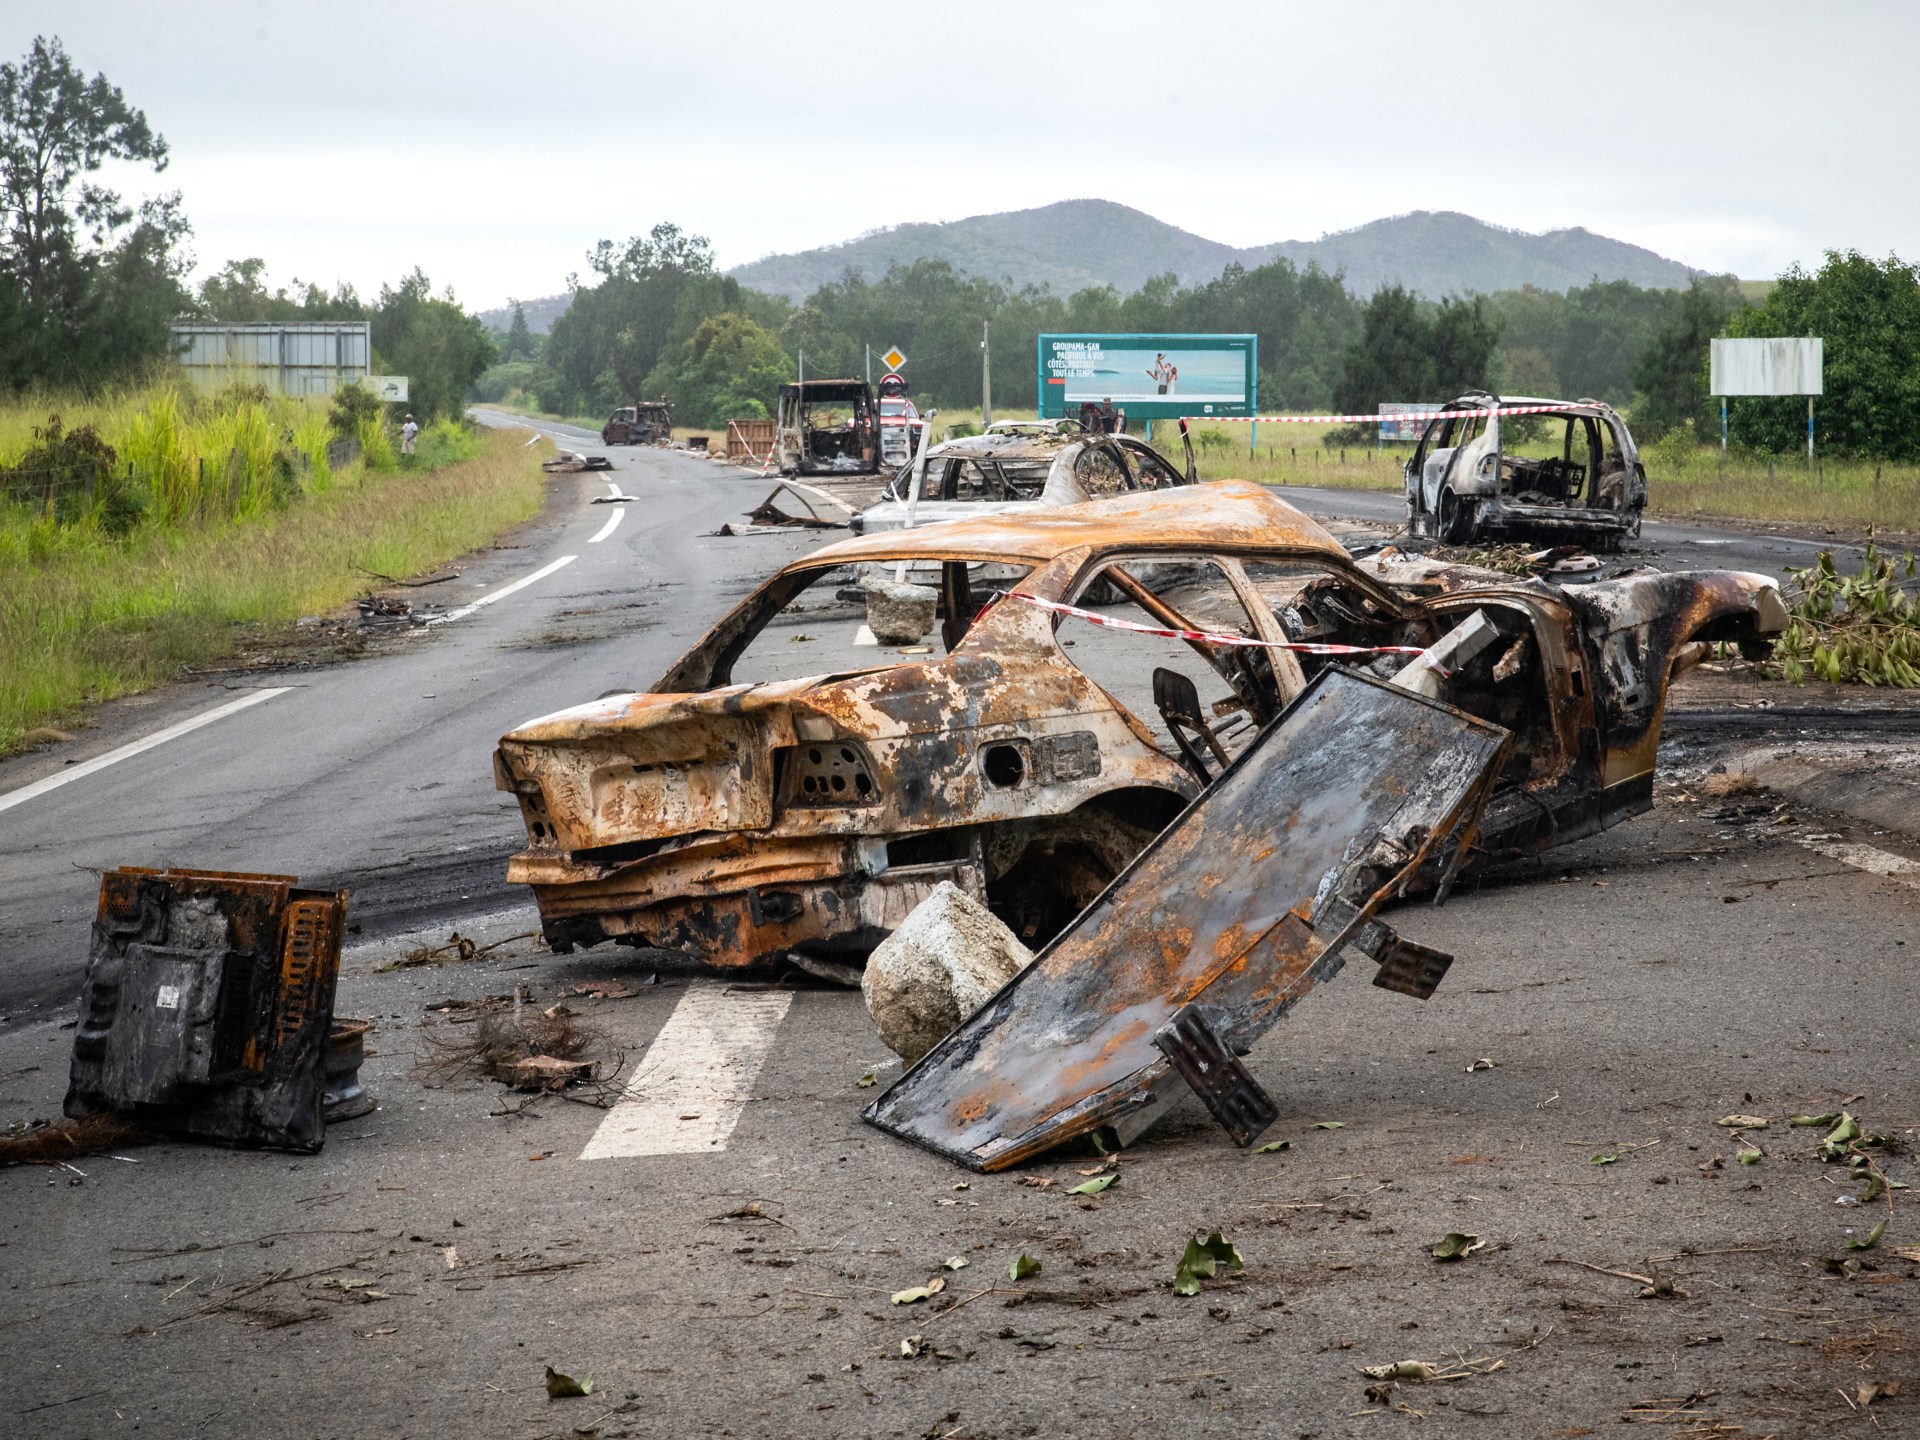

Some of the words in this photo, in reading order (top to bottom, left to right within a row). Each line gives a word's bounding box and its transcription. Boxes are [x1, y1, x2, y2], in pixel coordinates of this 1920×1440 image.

[1052, 342, 1100, 350] GROUPAMA-GAN
[1057, 351, 1086, 360] PACIFIQUE
[1092, 351, 1104, 360] VOS
[1068, 360, 1096, 369] PARTOUT,
[1052, 369, 1067, 377] TOUT
[1068, 369, 1075, 377] LE
[1076, 369, 1096, 377] TEMPS.
